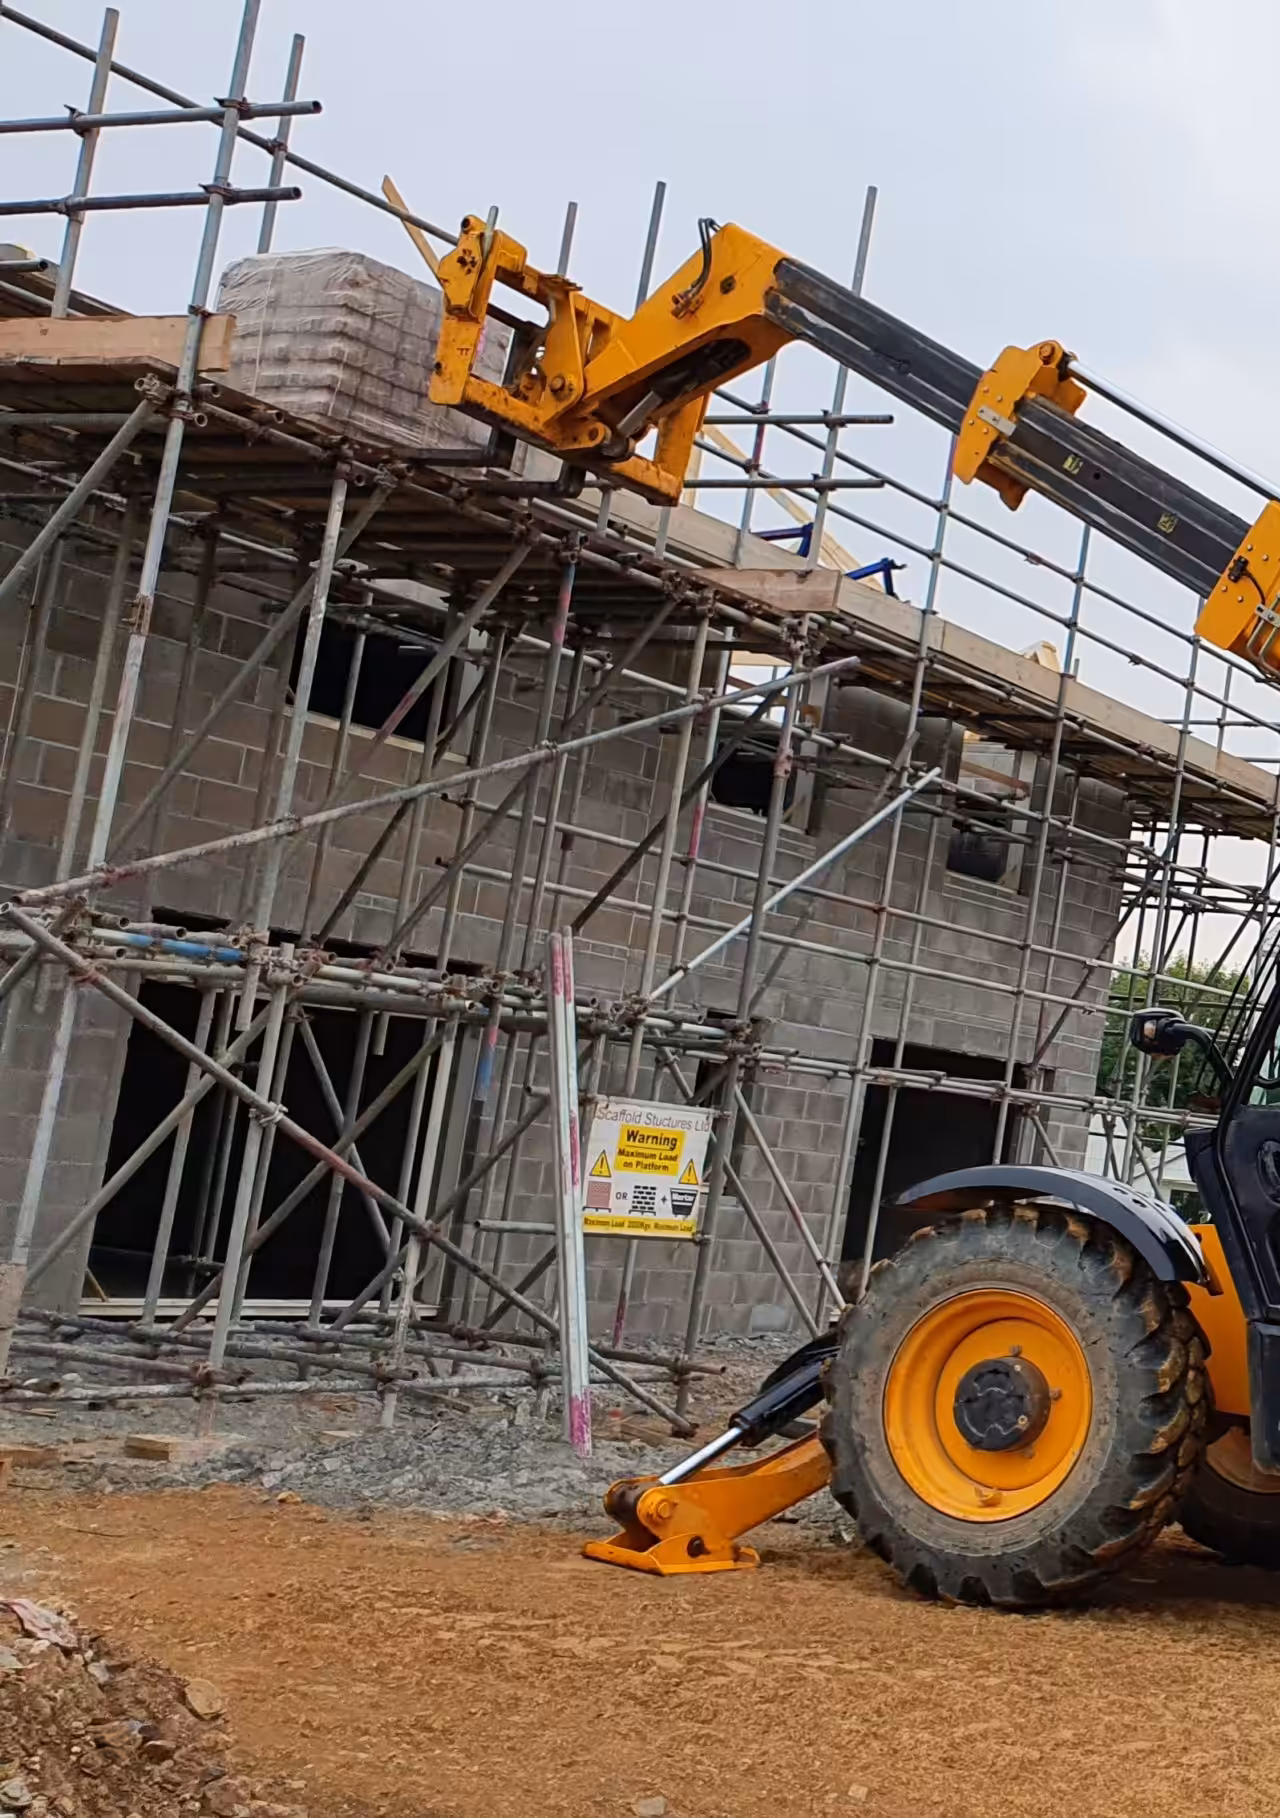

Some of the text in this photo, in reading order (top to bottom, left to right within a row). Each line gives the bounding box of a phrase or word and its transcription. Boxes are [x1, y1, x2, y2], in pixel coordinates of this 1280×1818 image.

[596, 1107, 642, 1124] Scaffold
[626, 1129, 677, 1151] Warning
[618, 1148, 678, 1162] Maximum Load
[636, 1161, 669, 1172] Platform
[615, 1191, 628, 1200] OR
